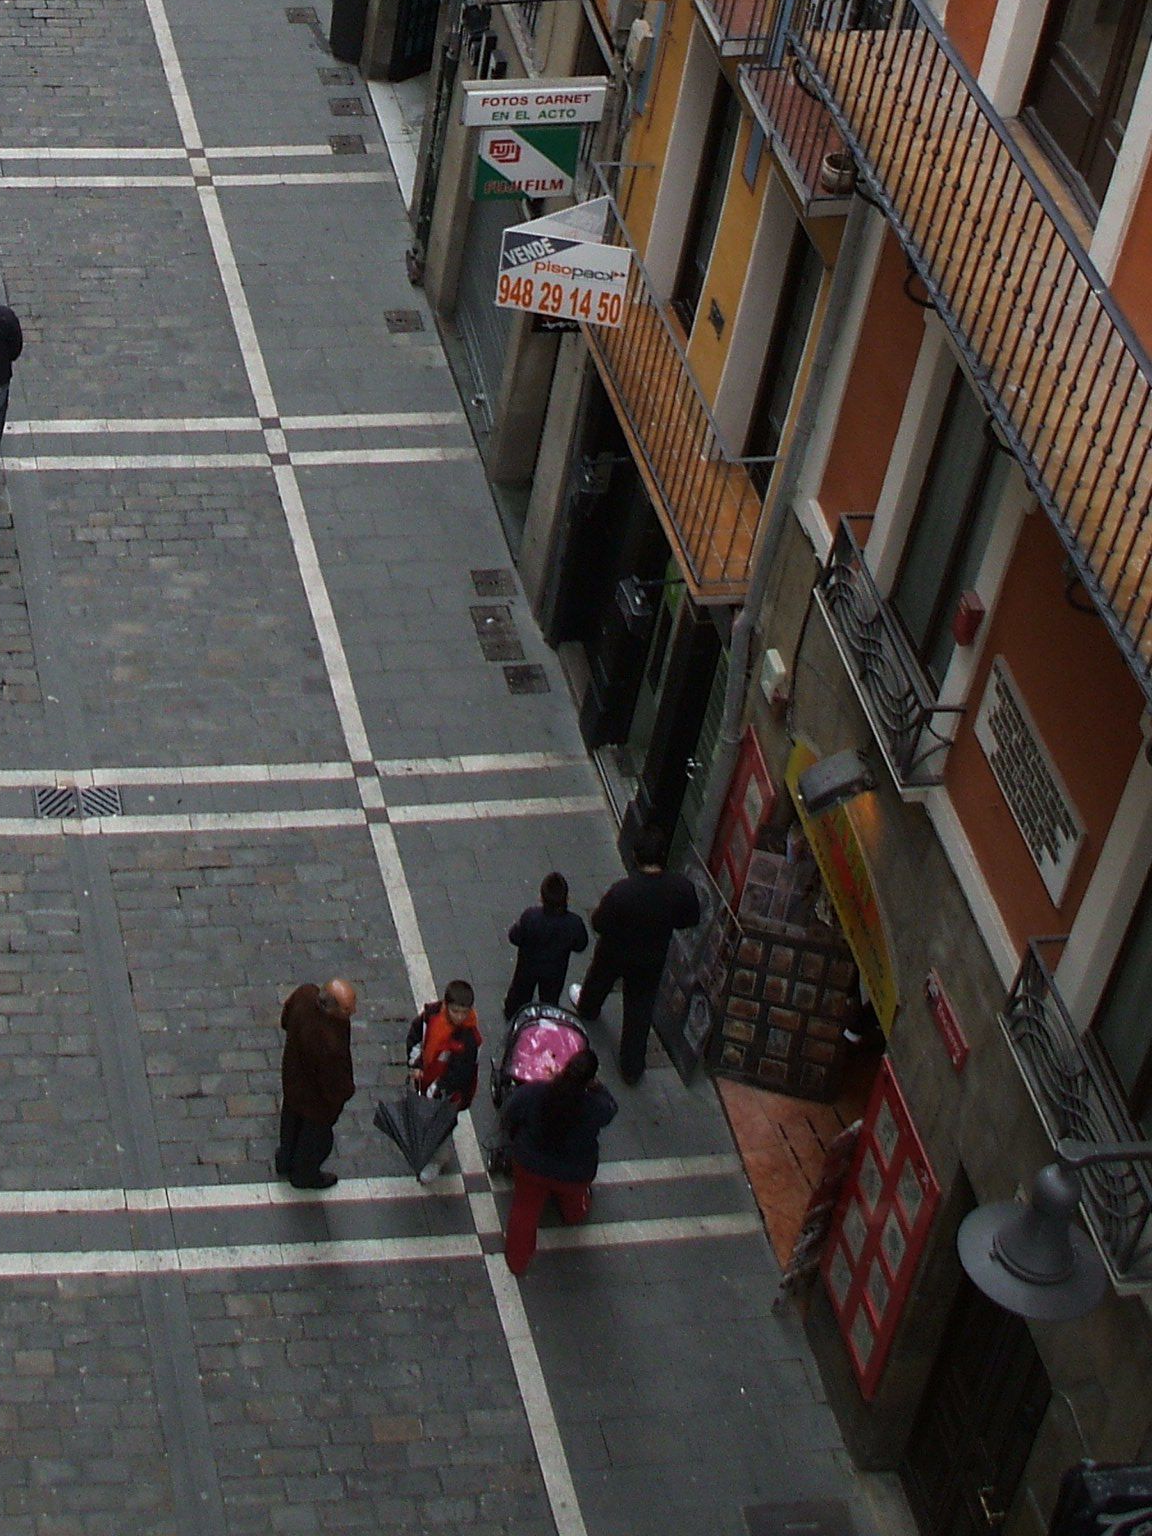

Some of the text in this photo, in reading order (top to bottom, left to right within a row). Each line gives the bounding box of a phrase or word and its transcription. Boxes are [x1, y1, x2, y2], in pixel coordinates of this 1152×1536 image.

[481, 94, 591, 107] FOTOS CARNET
[491, 108, 577, 121] EN EL ACTO
[504, 237, 556, 266] VENDE
[498, 274, 621, 325] 948 29 14 50
